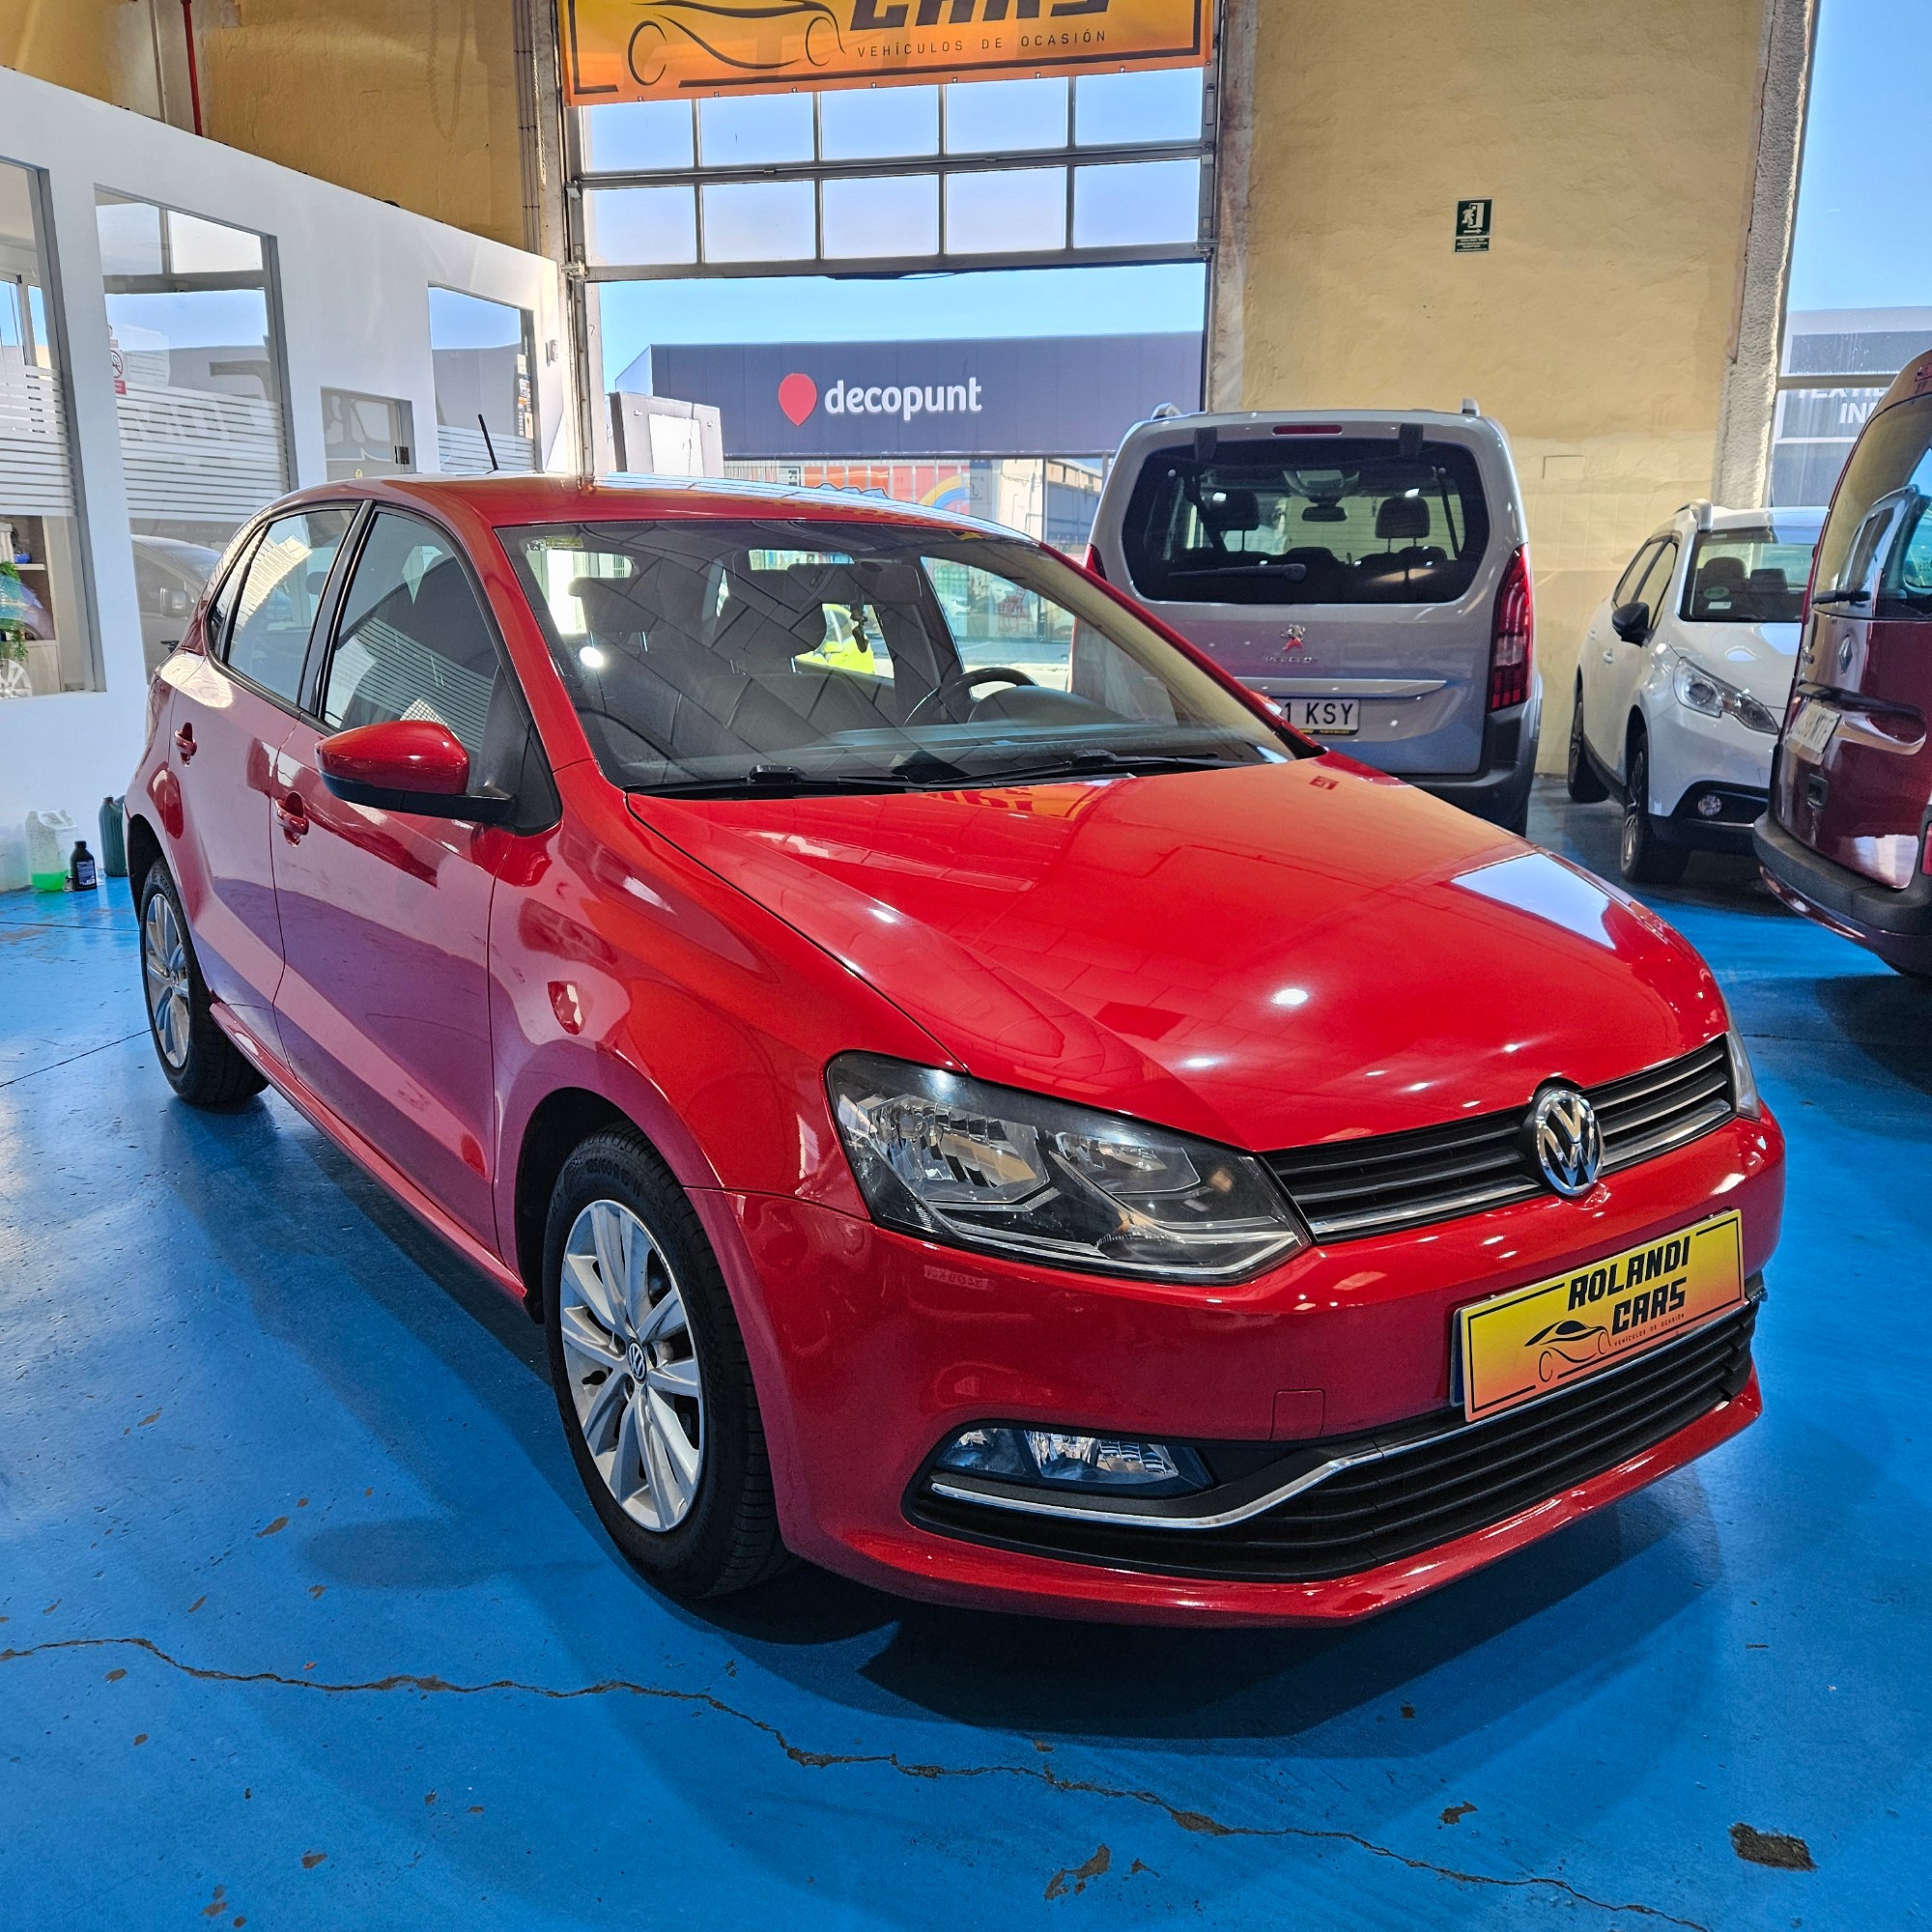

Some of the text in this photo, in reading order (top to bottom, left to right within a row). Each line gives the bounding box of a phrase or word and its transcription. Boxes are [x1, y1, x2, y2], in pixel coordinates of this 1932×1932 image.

[858, 28, 1106, 58] VEHÍCULOS DE OCASIÓN
[824, 377, 983, 422] decopunt
[1305, 701, 1353, 725] KSY
[1567, 1235, 1690, 1312] ROLANDI
[1611, 1276, 1688, 1336] CARS
